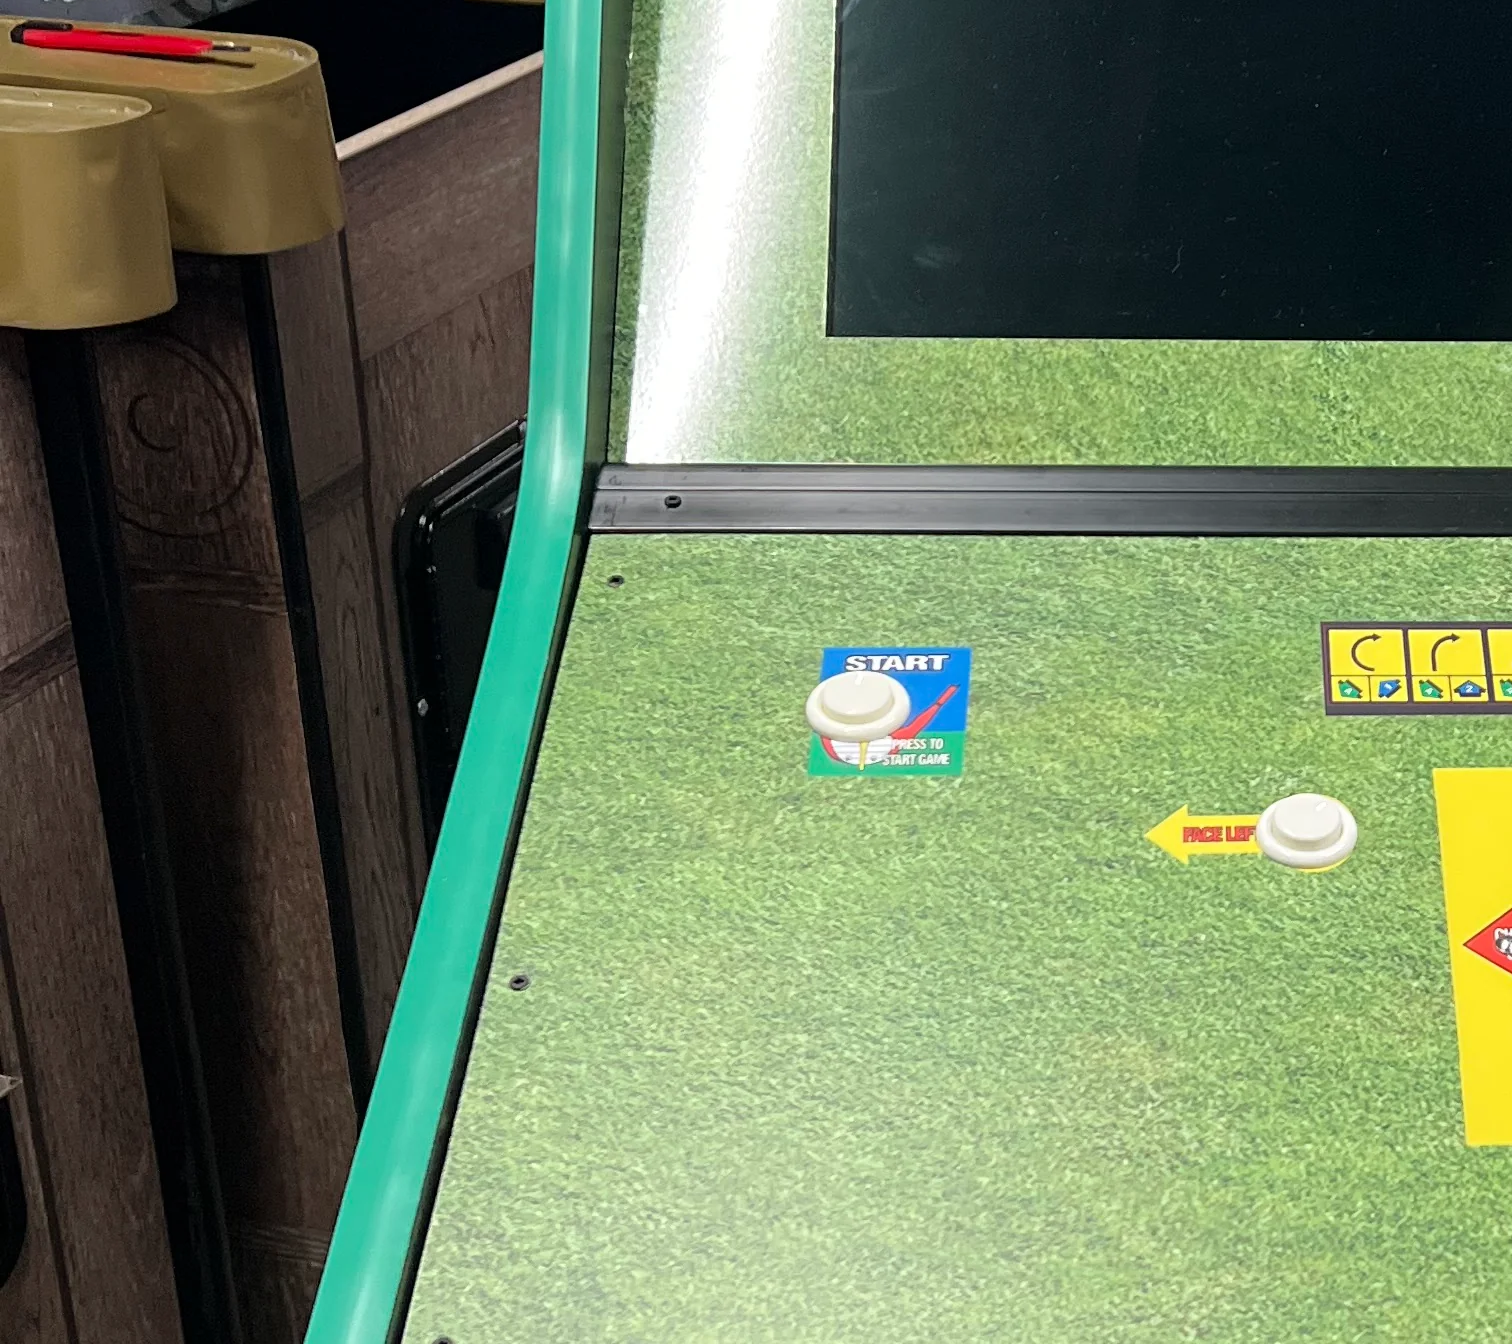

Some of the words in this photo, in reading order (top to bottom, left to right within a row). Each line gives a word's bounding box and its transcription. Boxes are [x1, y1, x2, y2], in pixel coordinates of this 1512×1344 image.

[845, 654, 951, 671] START
[892, 738, 926, 750] PRESS
[930, 738, 943, 750] TO
[882, 754, 916, 765] START
[918, 754, 950, 765] GAME
[1183, 826, 1223, 843] FACE
[1225, 826, 1257, 842] LEF
